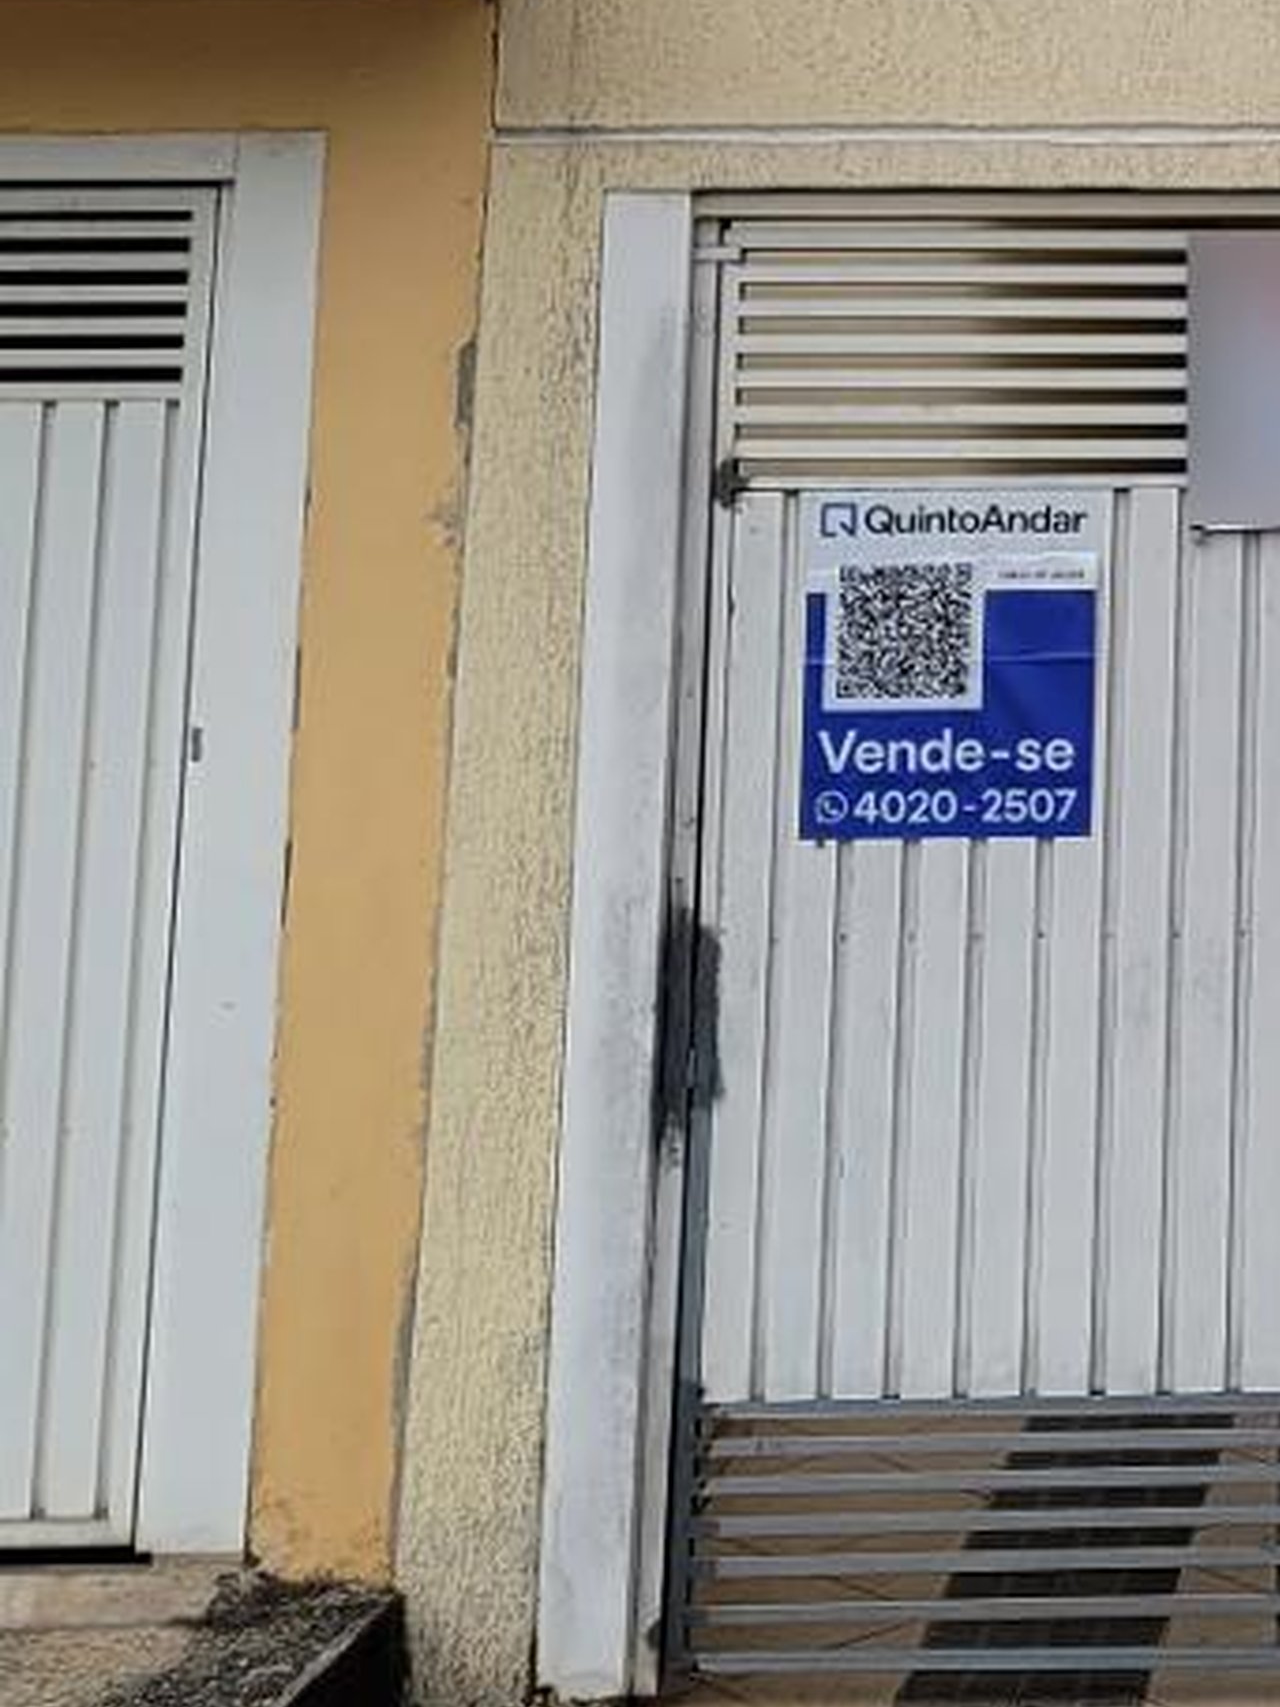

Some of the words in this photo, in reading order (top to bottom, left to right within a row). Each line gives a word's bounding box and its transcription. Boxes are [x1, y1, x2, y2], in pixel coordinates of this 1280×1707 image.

[863, 503, 1088, 536] QuintoAndar
[817, 728, 1075, 774] Vende-se
[852, 788, 1077, 824] 4020-2507
